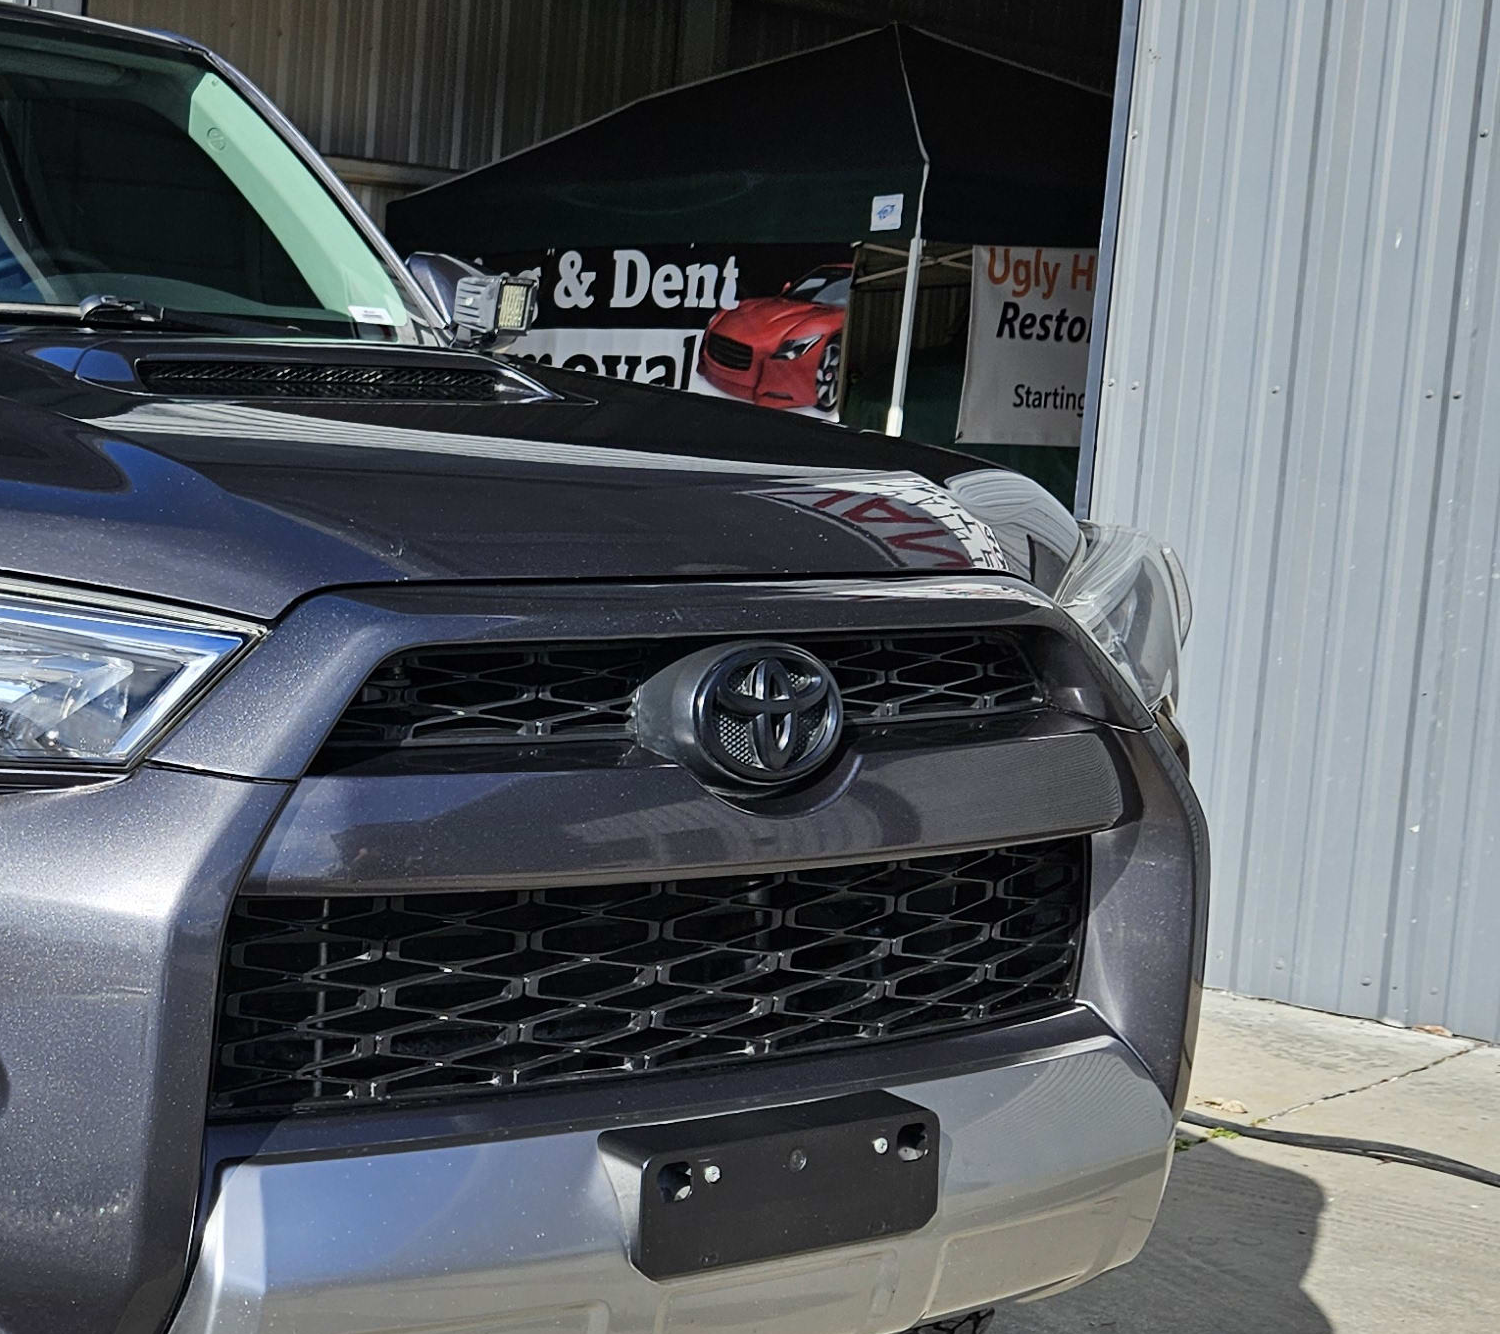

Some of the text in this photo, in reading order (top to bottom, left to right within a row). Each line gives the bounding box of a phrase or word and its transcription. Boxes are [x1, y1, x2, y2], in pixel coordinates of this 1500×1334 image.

[553, 250, 598, 309] &
[609, 249, 741, 311] Dent
[987, 247, 1061, 300] Ugly
